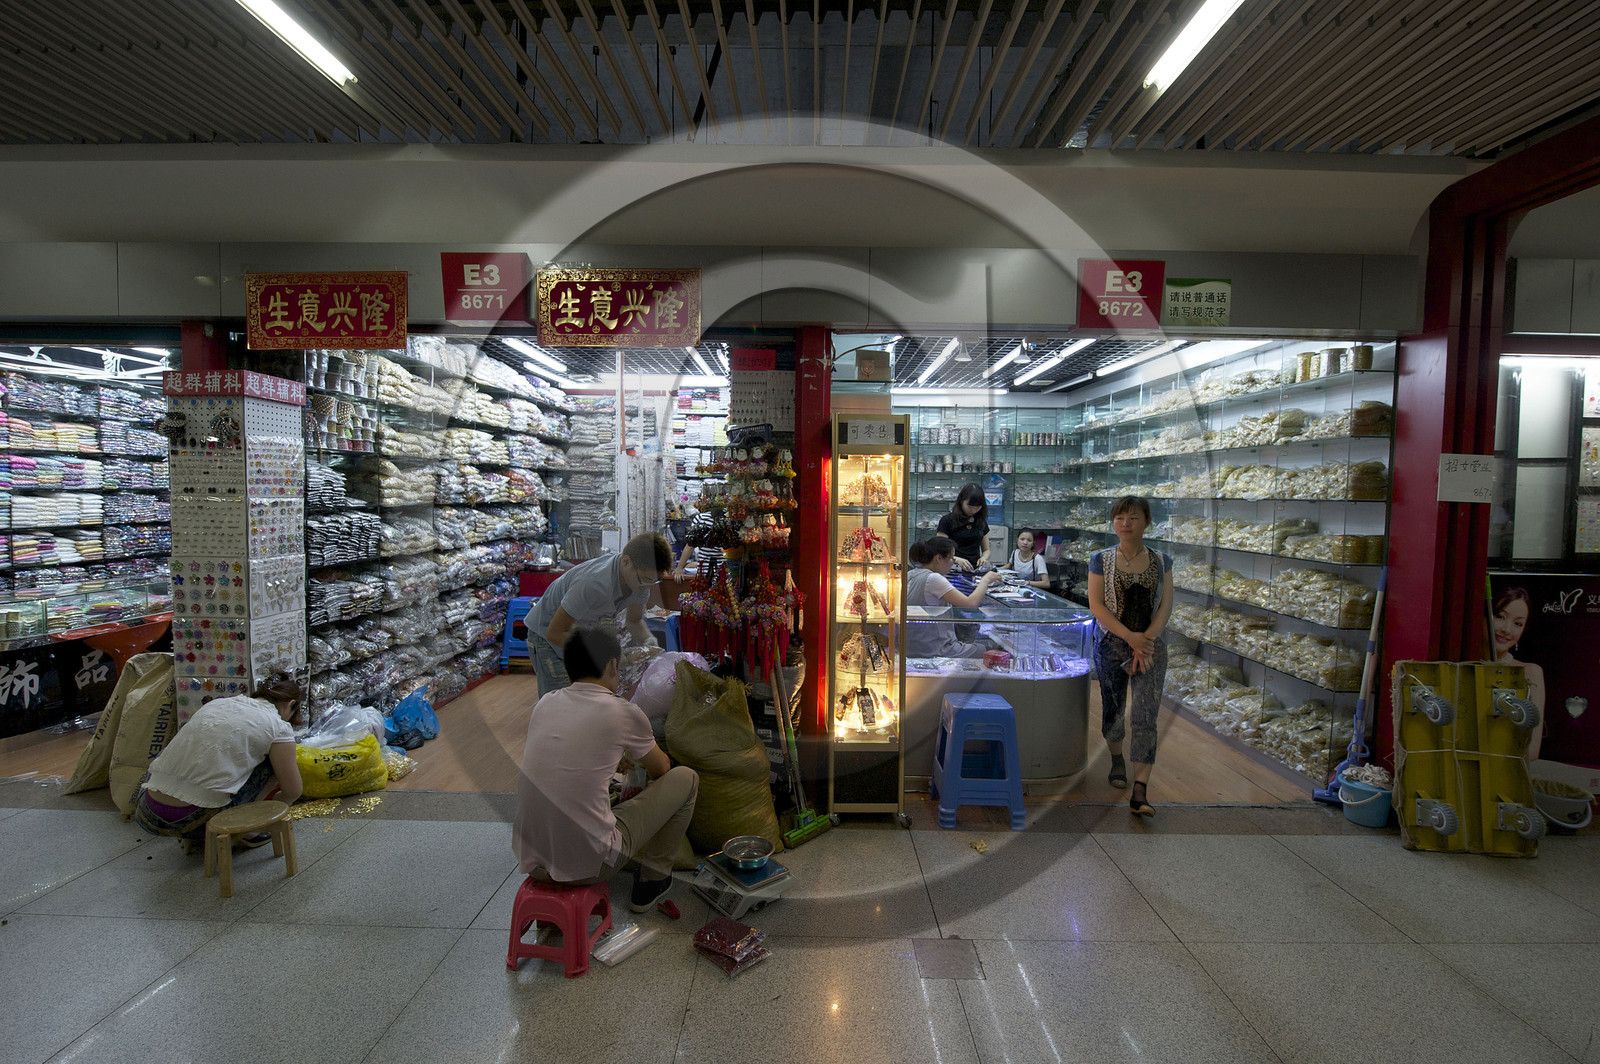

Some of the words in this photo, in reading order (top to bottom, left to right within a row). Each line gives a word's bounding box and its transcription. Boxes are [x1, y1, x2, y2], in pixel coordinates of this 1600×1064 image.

[463, 264, 500, 286] E3
[1105, 270, 1143, 292] E3
[461, 294, 503, 310] 8671
[555, 286, 684, 331] 生意兴隆
[1170, 292, 1227, 303] 请说普通话
[265, 288, 391, 333] 生意兴隆
[1098, 301, 1143, 317] 8672
[1169, 307, 1226, 318] 请写规范字
[165, 371, 242, 393] 超群辅料
[246, 373, 304, 403] 超群辅料
[850, 424, 888, 439] 可零售
[147, 701, 173, 760] TAIRIREX
